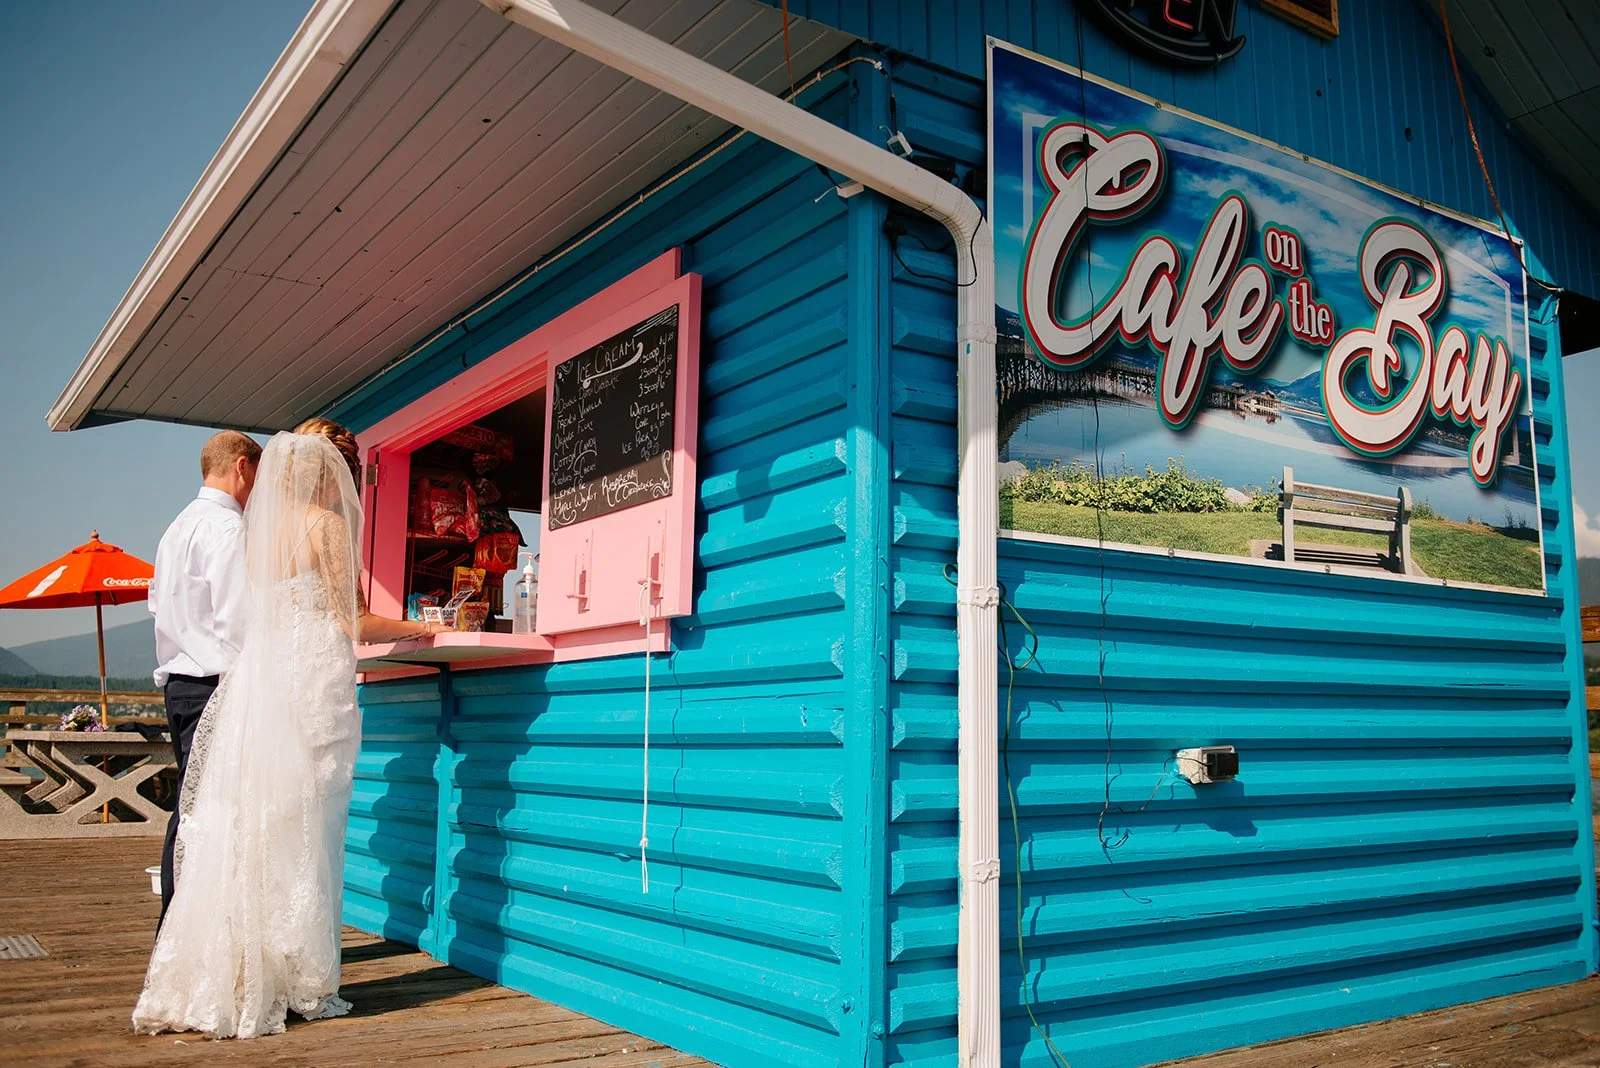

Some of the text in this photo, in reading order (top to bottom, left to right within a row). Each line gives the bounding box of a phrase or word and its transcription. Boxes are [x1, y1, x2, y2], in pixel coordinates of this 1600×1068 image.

[1020, 120, 1521, 486] Cafe on the Bay
[102, 577, 154, 587] Coca-Col
